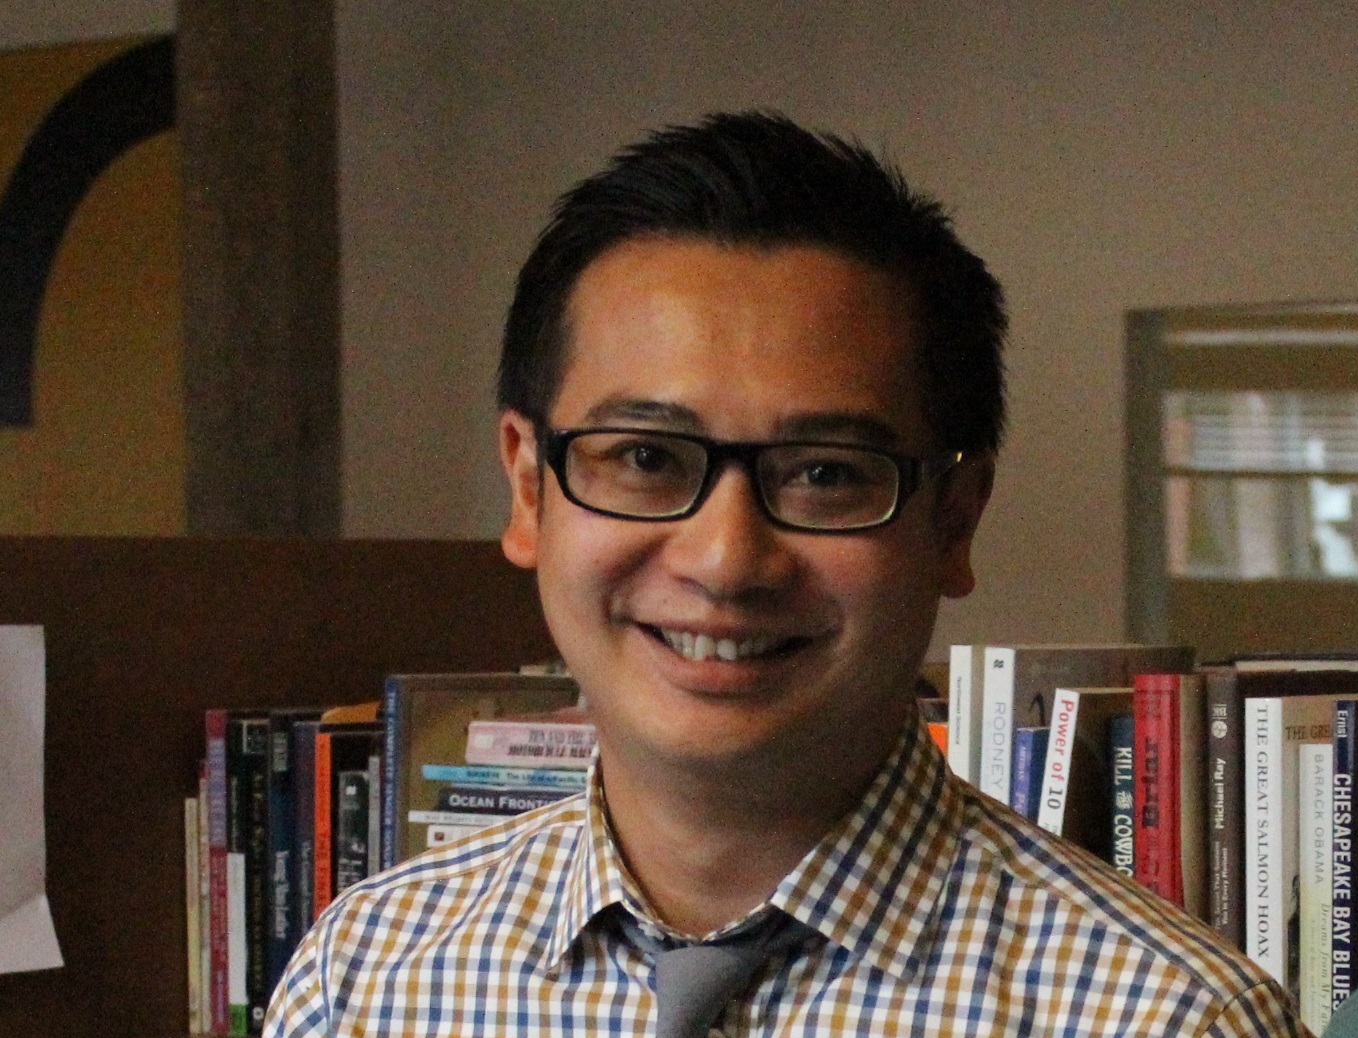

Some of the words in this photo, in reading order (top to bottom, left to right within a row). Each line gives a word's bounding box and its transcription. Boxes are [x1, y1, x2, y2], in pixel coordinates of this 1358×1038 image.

[1055, 699, 1076, 755] Power
[1257, 705, 1269, 745] THE
[1285, 726, 1306, 739] THE
[1337, 710, 1348, 738] Ernst
[991, 702, 1006, 790] RODNEY
[1050, 761, 1064, 780] of
[1114, 748, 1132, 785] KILL
[1215, 758, 1227, 779] Ray
[1257, 752, 1269, 814] GREAT
[449, 795, 495, 808] OCEAN
[1046, 786, 1063, 810] 10
[1214, 783, 1225, 829] Michael
[1315, 755, 1324, 820] BARACK
[1315, 827, 1324, 883] OBAMA
[1333, 774, 1352, 899] CHESAPEAKE
[1257, 820, 1269, 898] SALMON
[1257, 905, 1269, 957] HOAX
[1321, 903, 1330, 947] Dreams
[1333, 907, 1351, 943] BAY
[1320, 951, 1330, 978] from
[1321, 983, 1329, 998] My
